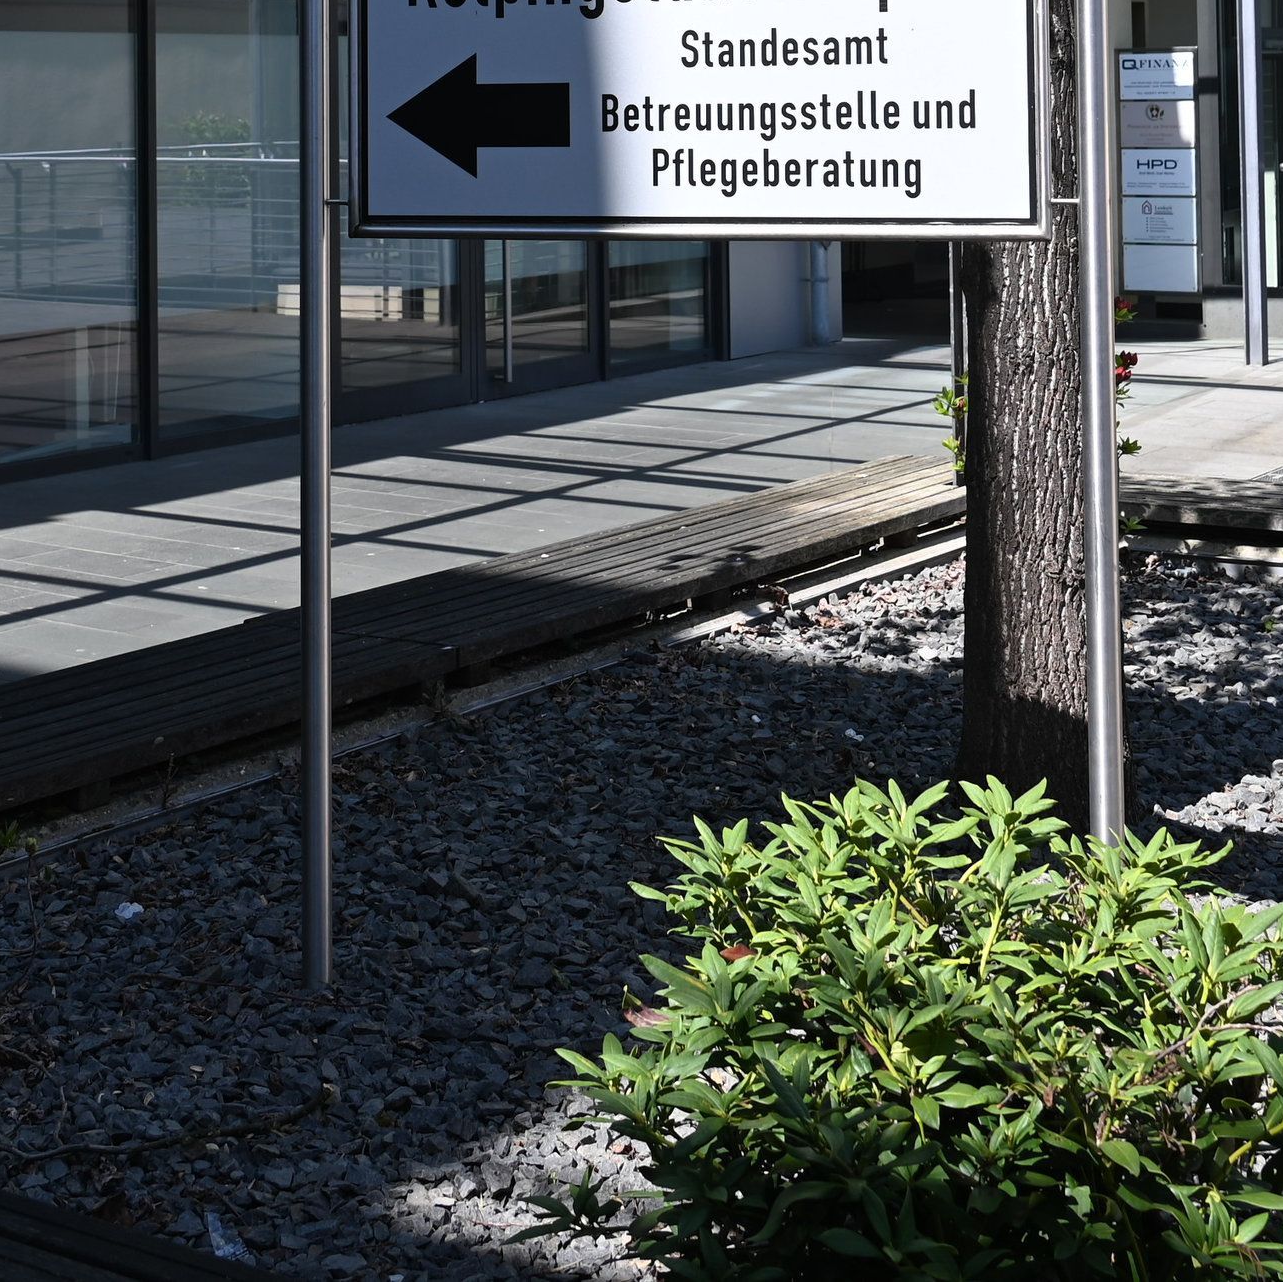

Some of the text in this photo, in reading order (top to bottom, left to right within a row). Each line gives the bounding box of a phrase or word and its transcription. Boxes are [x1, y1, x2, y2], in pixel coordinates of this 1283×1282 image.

[680, 28, 889, 67] Standesamt
[601, 89, 977, 142] Betreuungsstelle und
[651, 148, 922, 198] Pflegeberatung
[1136, 159, 1178, 170] HPD
